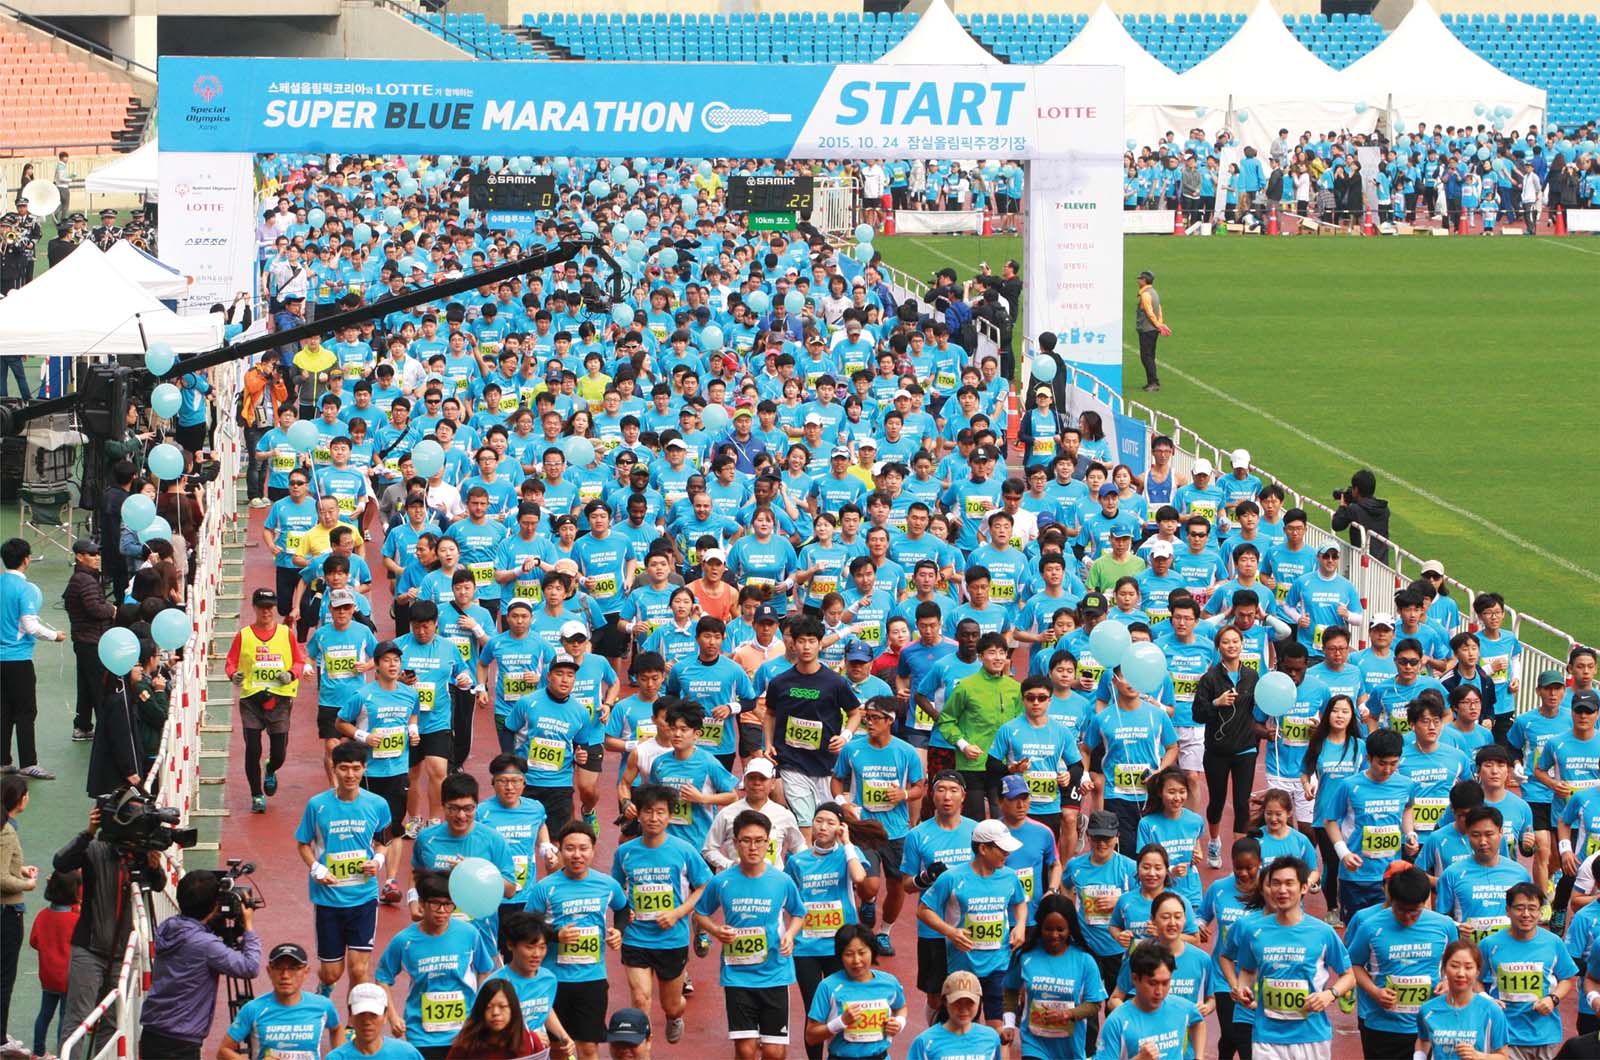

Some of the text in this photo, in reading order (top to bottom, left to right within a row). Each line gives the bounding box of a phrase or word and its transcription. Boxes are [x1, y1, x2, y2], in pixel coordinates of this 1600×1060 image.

[376, 83, 433, 96] LOTTE
[444, 88, 473, 97] 함께하는
[835, 81, 1026, 126] START
[190, 106, 226, 114] Special
[1038, 107, 1097, 118] LOTTE
[185, 115, 231, 123] Olympics
[263, 100, 694, 132] SUPER BLUE MARATHON
[818, 136, 1027, 150] 2015. 10. 24 잠실올림픽주경기장
[497, 176, 537, 184] SAMIK
[756, 177, 796, 185] SAMIK
[186, 203, 225, 212] LOTTE
[755, 216, 790, 225] 10km 코스
[499, 398, 517, 409] 1357
[1122, 437, 1139, 456] LOTTE
[274, 457, 294, 467] 1499
[516, 586, 539, 596] 1401
[593, 582, 614, 592] 406
[812, 582, 835, 593] 2307
[991, 585, 1014, 596] 1149
[328, 659, 355, 671] 1526
[538, 722, 567, 731] MARATHON
[556, 720, 570, 728] BLUE
[788, 727, 819, 742] 1624
[377, 736, 404, 748] 054
[531, 746, 562, 762] 1661
[1117, 773, 1144, 785] 137
[1411, 774, 1448, 782] MARATHON
[1028, 780, 1055, 793] 1218
[1366, 835, 1399, 850] 1380
[934, 855, 972, 863] MARATHON
[330, 860, 364, 877] 1163
[803, 879, 839, 888] MARATHON
[636, 894, 672, 909] 1216
[732, 898, 755, 906] SUPER
[563, 906, 601, 915] MARATHON
[732, 905, 771, 913] MARATHON
[804, 911, 842, 927] 2148
[968, 924, 1003, 939] 1945
[728, 938, 764, 953] 1428
[1389, 943, 1432, 952] SUPER BLUE
[1263, 954, 1305, 962] MARATHON
[1389, 951, 1432, 960] MARATHON
[418, 957, 437, 965] SUPER
[418, 963, 459, 973] MARATHON
[1032, 976, 1075, 985] SUPER BLUE
[1501, 975, 1540, 990] 1112
[1032, 983, 1074, 994] MARATHON
[1265, 992, 1305, 1008] 1106
[425, 1004, 464, 1019] 1375
[266, 1024, 314, 1033] SUPER BLUE
[265, 1033, 314, 1041] MARATHON
[1433, 1030, 1478, 1038] SUPER BLUE
[1156, 1040, 1180, 1048] ATHON
[1433, 1037, 1477, 1046] MARATHON
